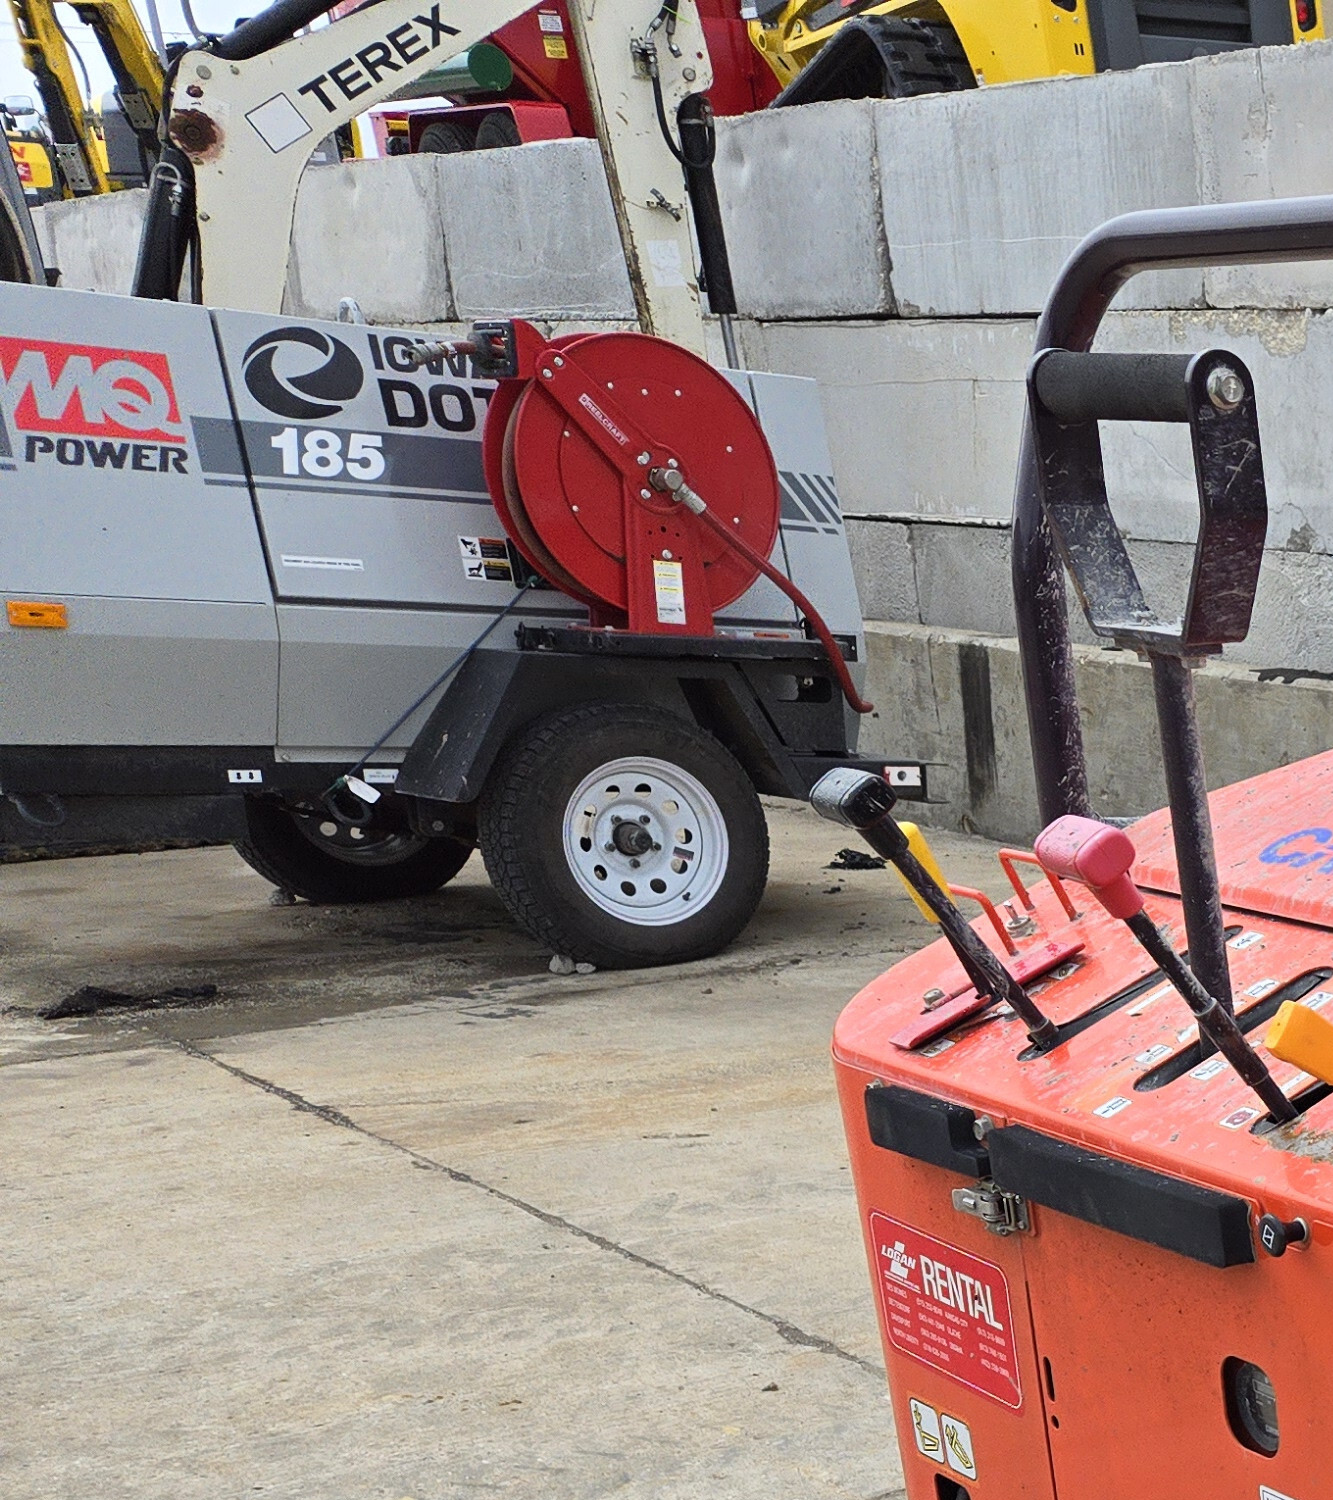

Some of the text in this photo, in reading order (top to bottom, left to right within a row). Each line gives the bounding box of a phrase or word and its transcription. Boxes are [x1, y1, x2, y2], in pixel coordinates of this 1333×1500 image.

[297, 3, 462, 113] TEREX
[367, 333, 478, 379] IOW
[0, 350, 182, 431] MQ
[25, 435, 189, 475] POWER
[271, 427, 385, 481] 185
[881, 1245, 916, 1269] LOGAN
[919, 1254, 1003, 1331] RENTAL
